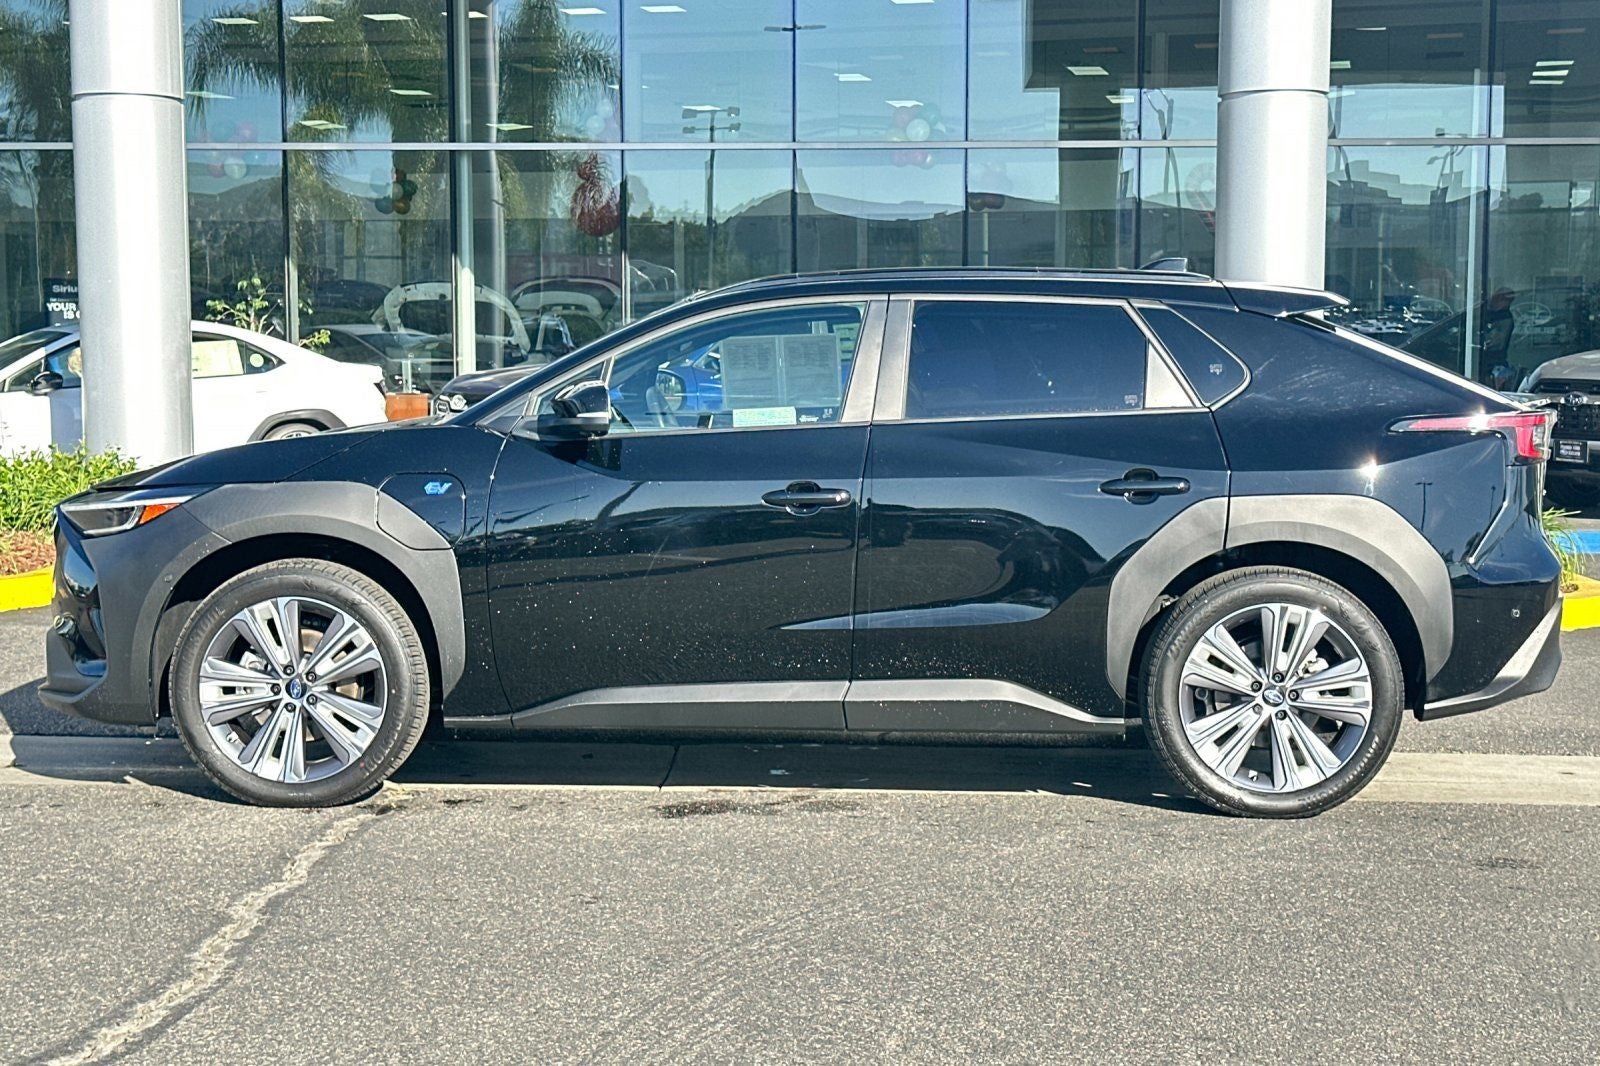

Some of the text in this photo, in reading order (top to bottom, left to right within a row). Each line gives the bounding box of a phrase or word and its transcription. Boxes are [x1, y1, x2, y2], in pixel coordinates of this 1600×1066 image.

[52, 284, 78, 293] Siriu
[46, 302, 77, 312] YOUR
[63, 310, 75, 320] IS
